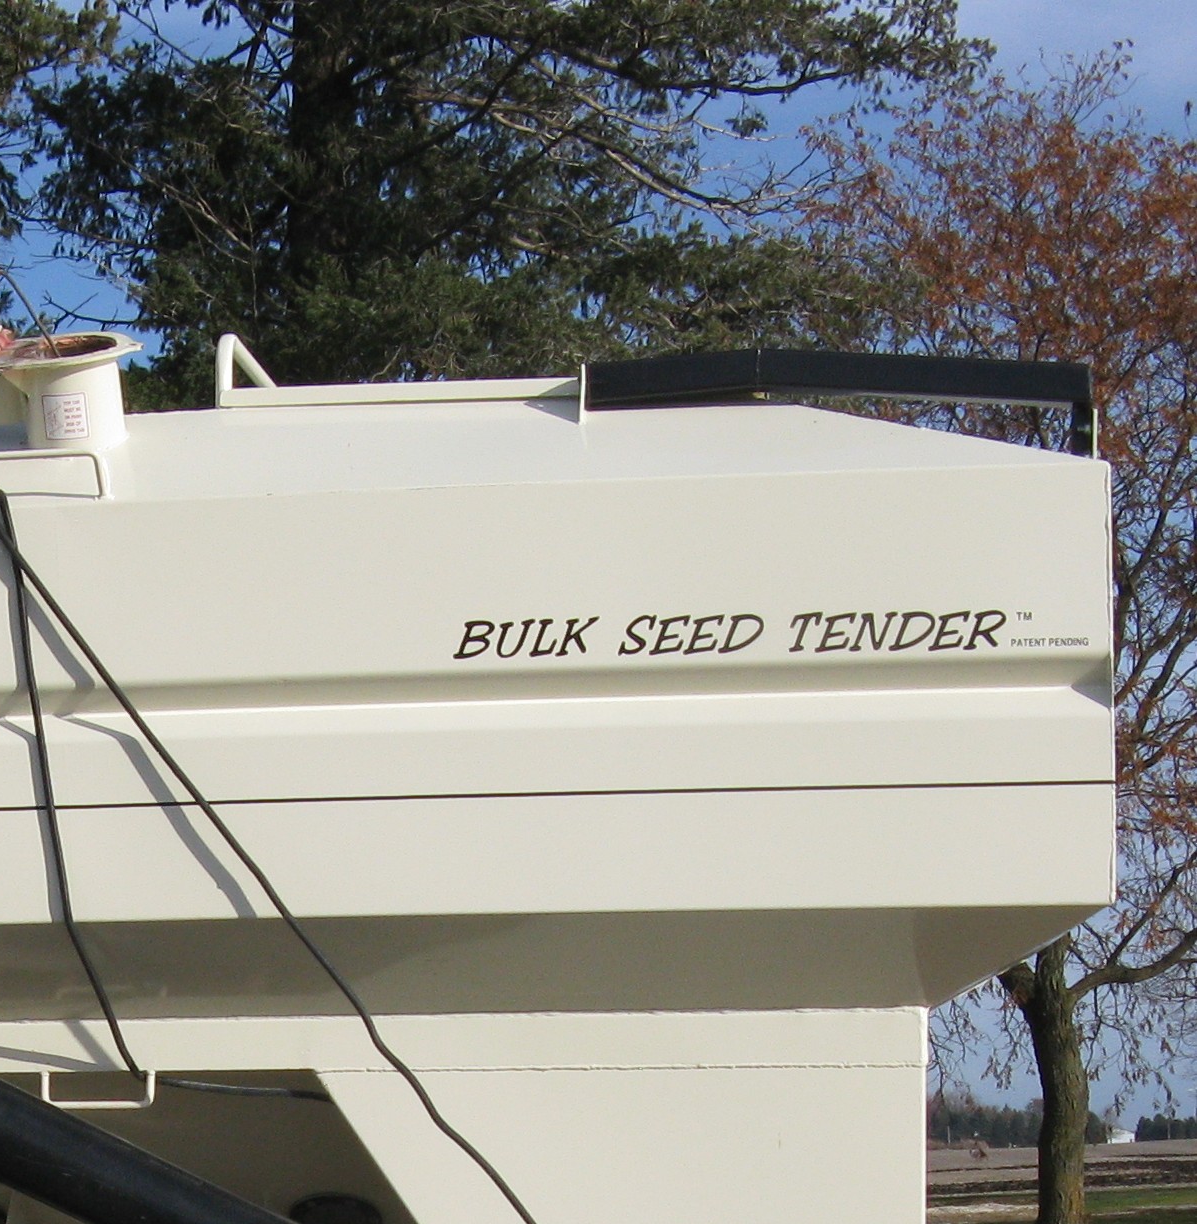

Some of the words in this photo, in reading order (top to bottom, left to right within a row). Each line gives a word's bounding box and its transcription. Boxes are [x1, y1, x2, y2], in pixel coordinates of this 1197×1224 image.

[452, 615, 601, 660] BULK
[617, 613, 765, 656] SEED
[788, 609, 1007, 653] TENDER
[1010, 637, 1047, 648] PATENT
[1048, 636, 1090, 648] PENDING
